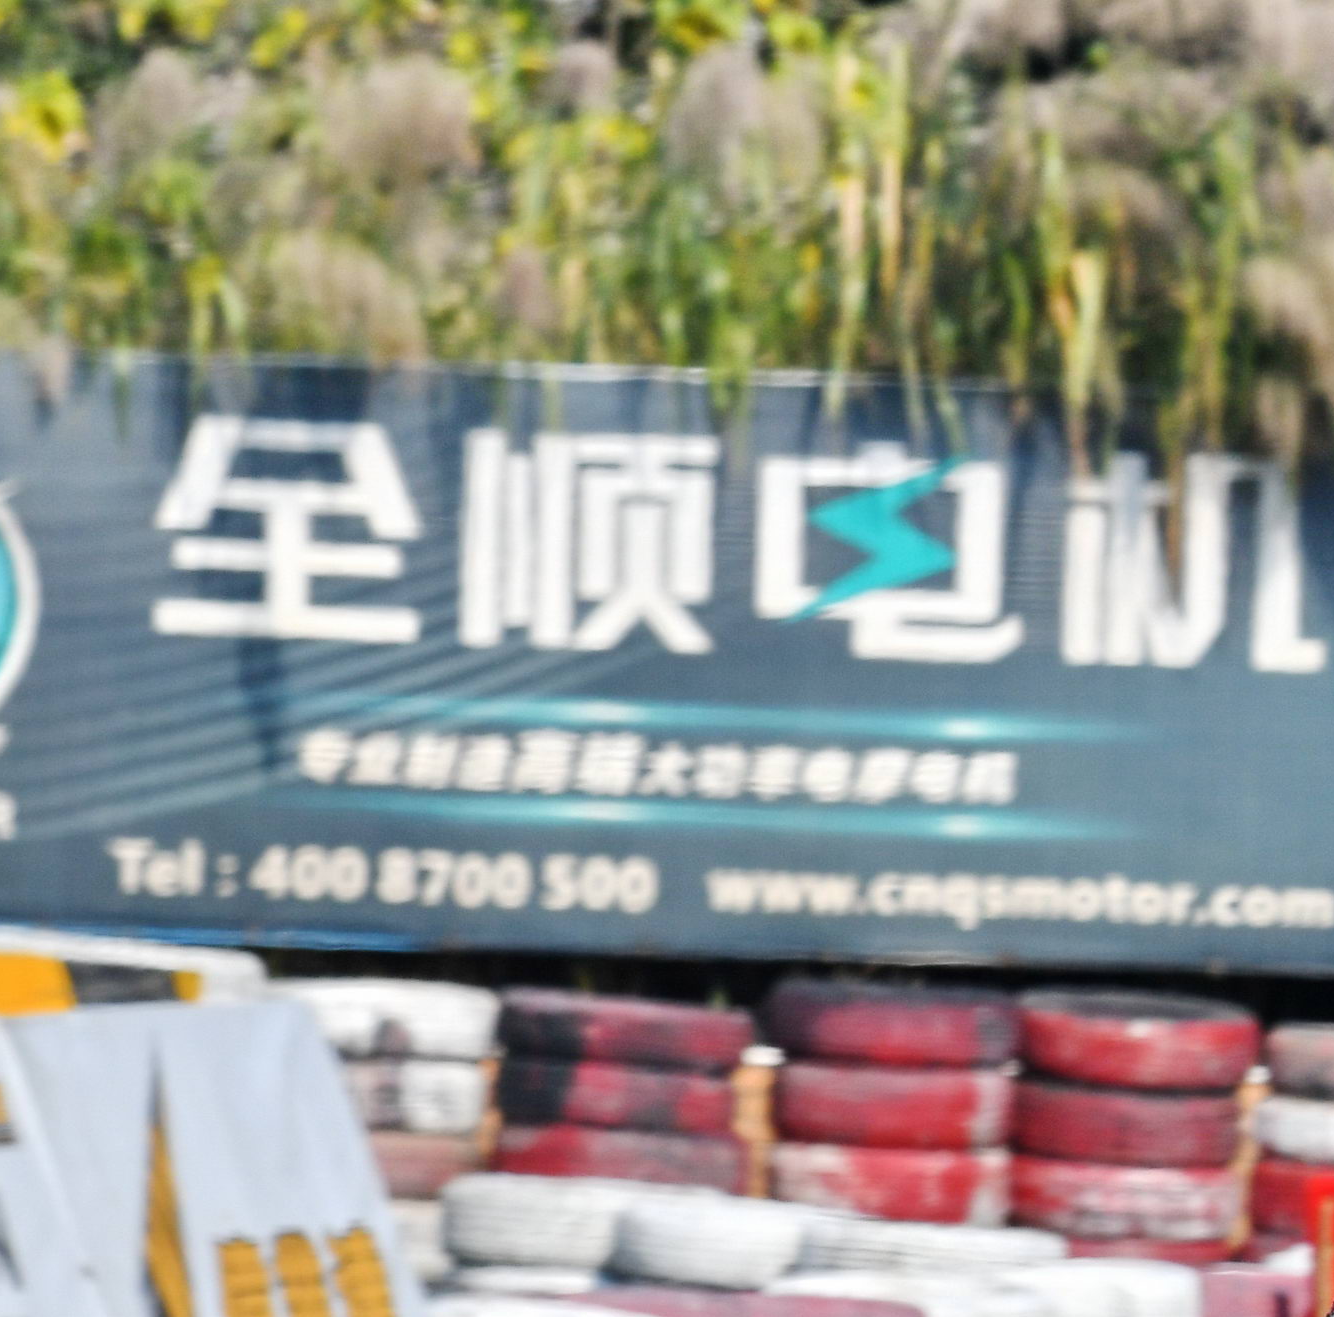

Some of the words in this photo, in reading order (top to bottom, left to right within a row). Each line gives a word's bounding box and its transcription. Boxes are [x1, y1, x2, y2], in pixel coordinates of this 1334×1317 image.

[153, 414, 1328, 674] 全顺电机
[248, 844, 369, 902] 400
[374, 847, 531, 908] 8700
[539, 852, 660, 914] 500
